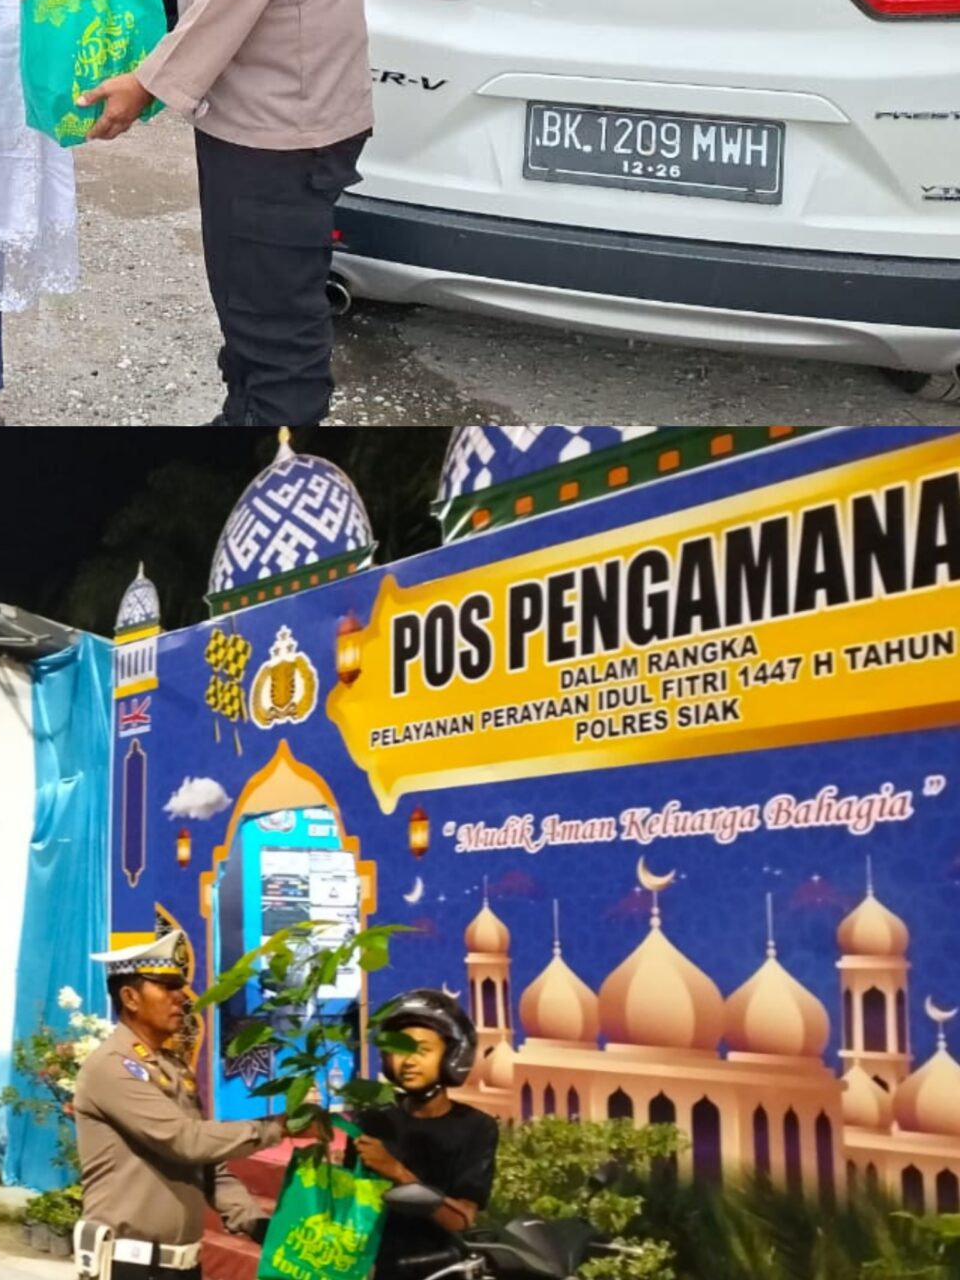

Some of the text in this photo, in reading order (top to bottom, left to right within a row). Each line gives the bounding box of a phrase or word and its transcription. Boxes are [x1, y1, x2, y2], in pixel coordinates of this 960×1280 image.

[542, 110, 769, 168] BK 1209 MWH
[392, 471, 960, 695] POS PENGAMANA
[370, 630, 955, 748] PELAYANAN PERAYAAN IDUL FITRI 1447 H TAHUN
[560, 635, 759, 690] DALAM RANGKA
[575, 698, 741, 742] POLRES SIAK
[541, 814, 617, 844] Aman
[620, 800, 760, 844] Keluarga
[764, 783, 914, 835] Bahagia
